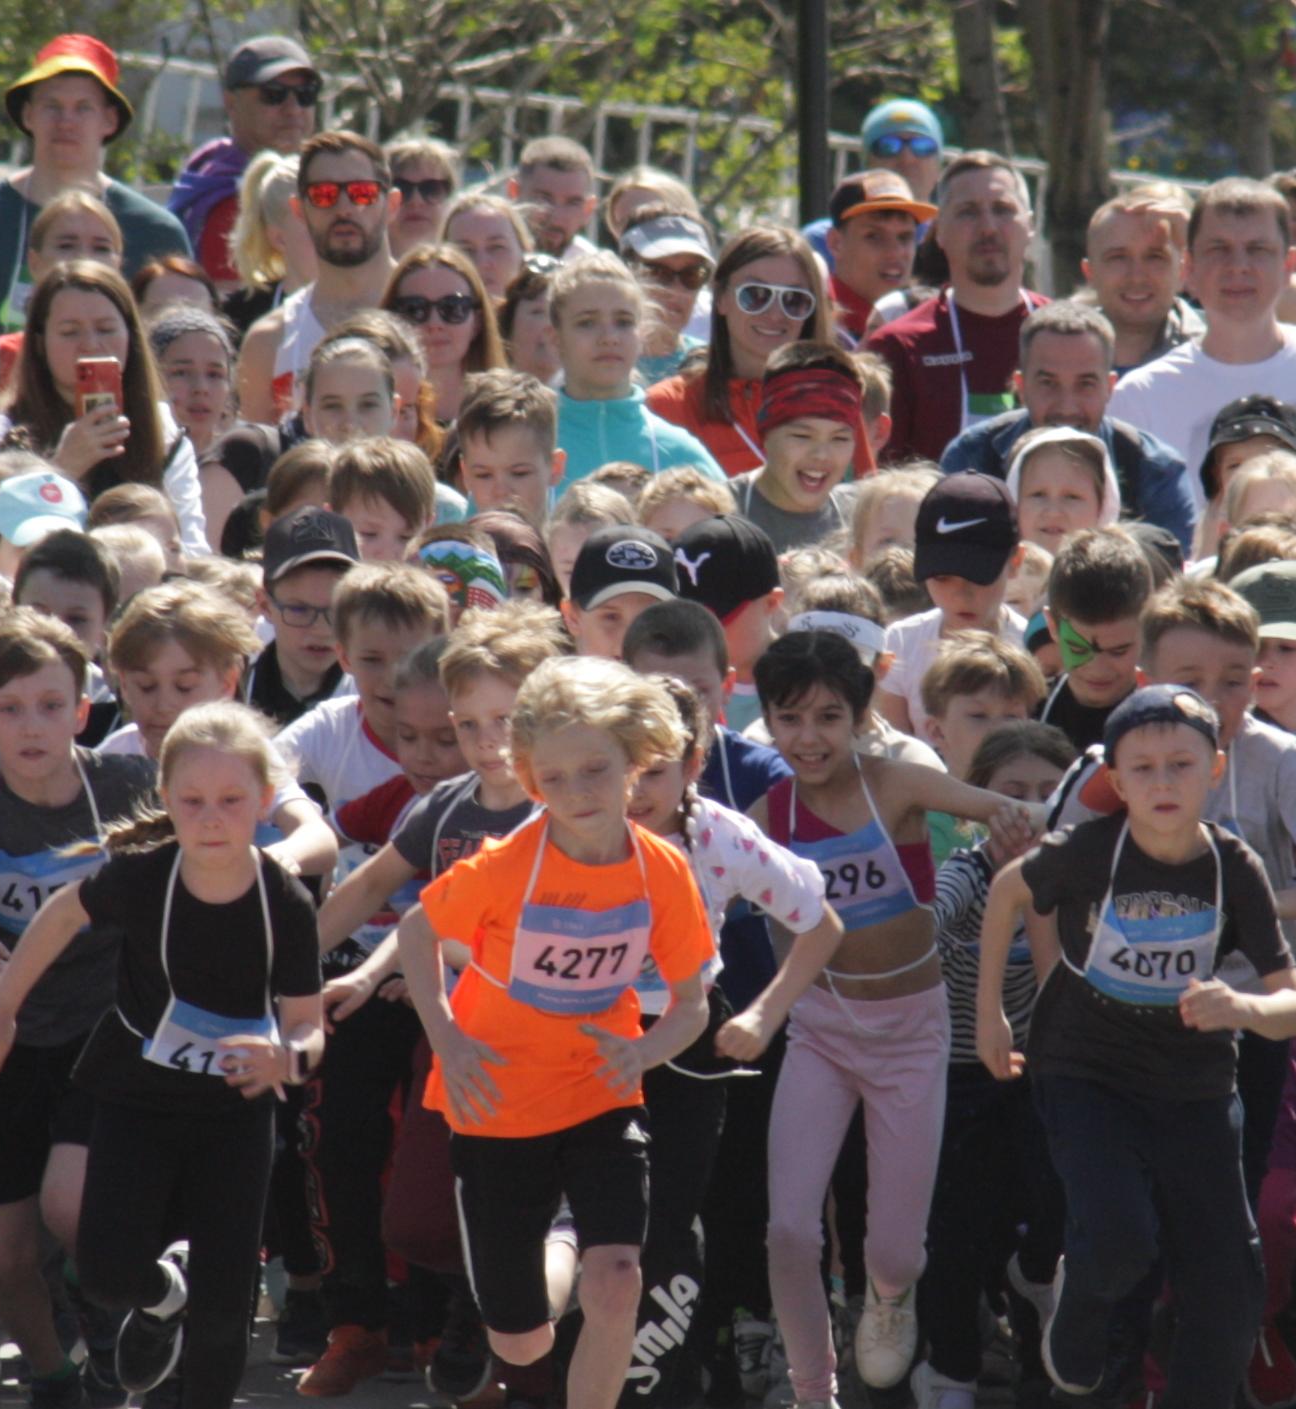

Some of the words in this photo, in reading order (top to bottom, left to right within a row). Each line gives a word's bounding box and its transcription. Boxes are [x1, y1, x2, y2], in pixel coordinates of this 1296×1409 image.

[821, 860, 886, 900] 296
[533, 942, 629, 979] 4277
[1110, 947, 1196, 981] 4070
